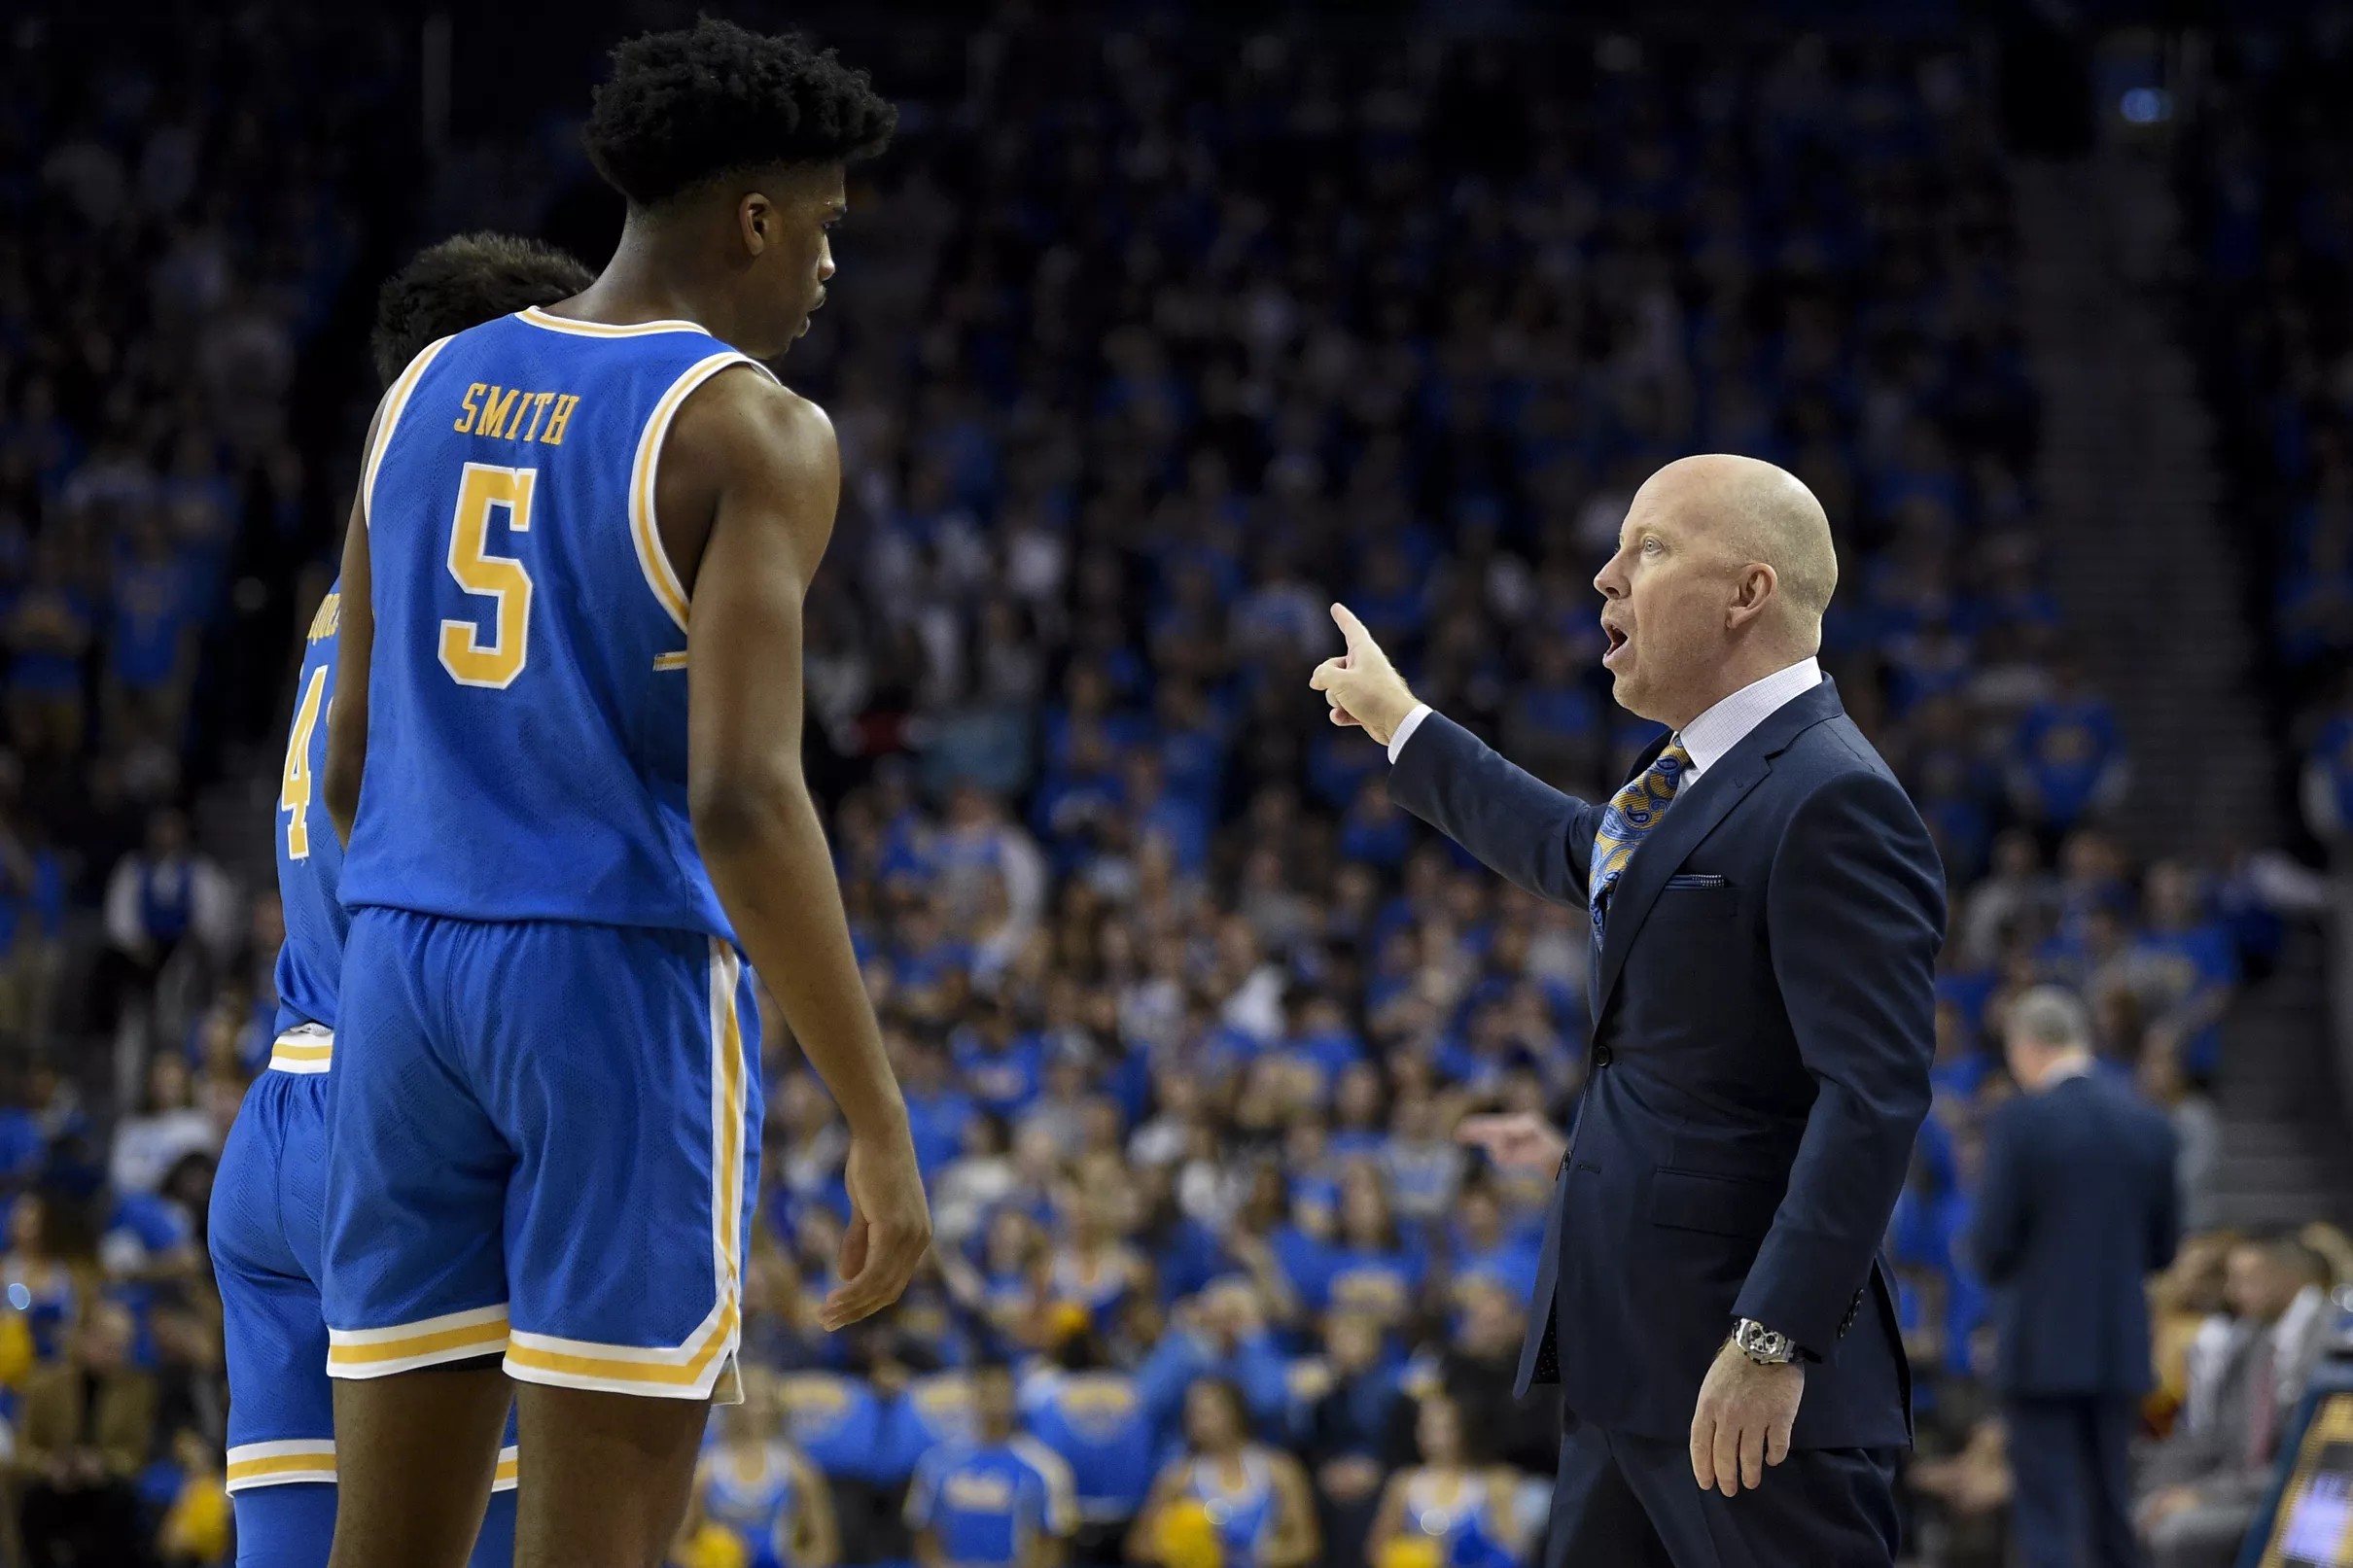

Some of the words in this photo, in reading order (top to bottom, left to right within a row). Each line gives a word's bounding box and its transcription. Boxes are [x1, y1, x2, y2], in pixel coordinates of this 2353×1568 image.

[454, 382, 579, 445] SMITH
[438, 462, 538, 690] 5
[281, 665, 329, 860] 4
